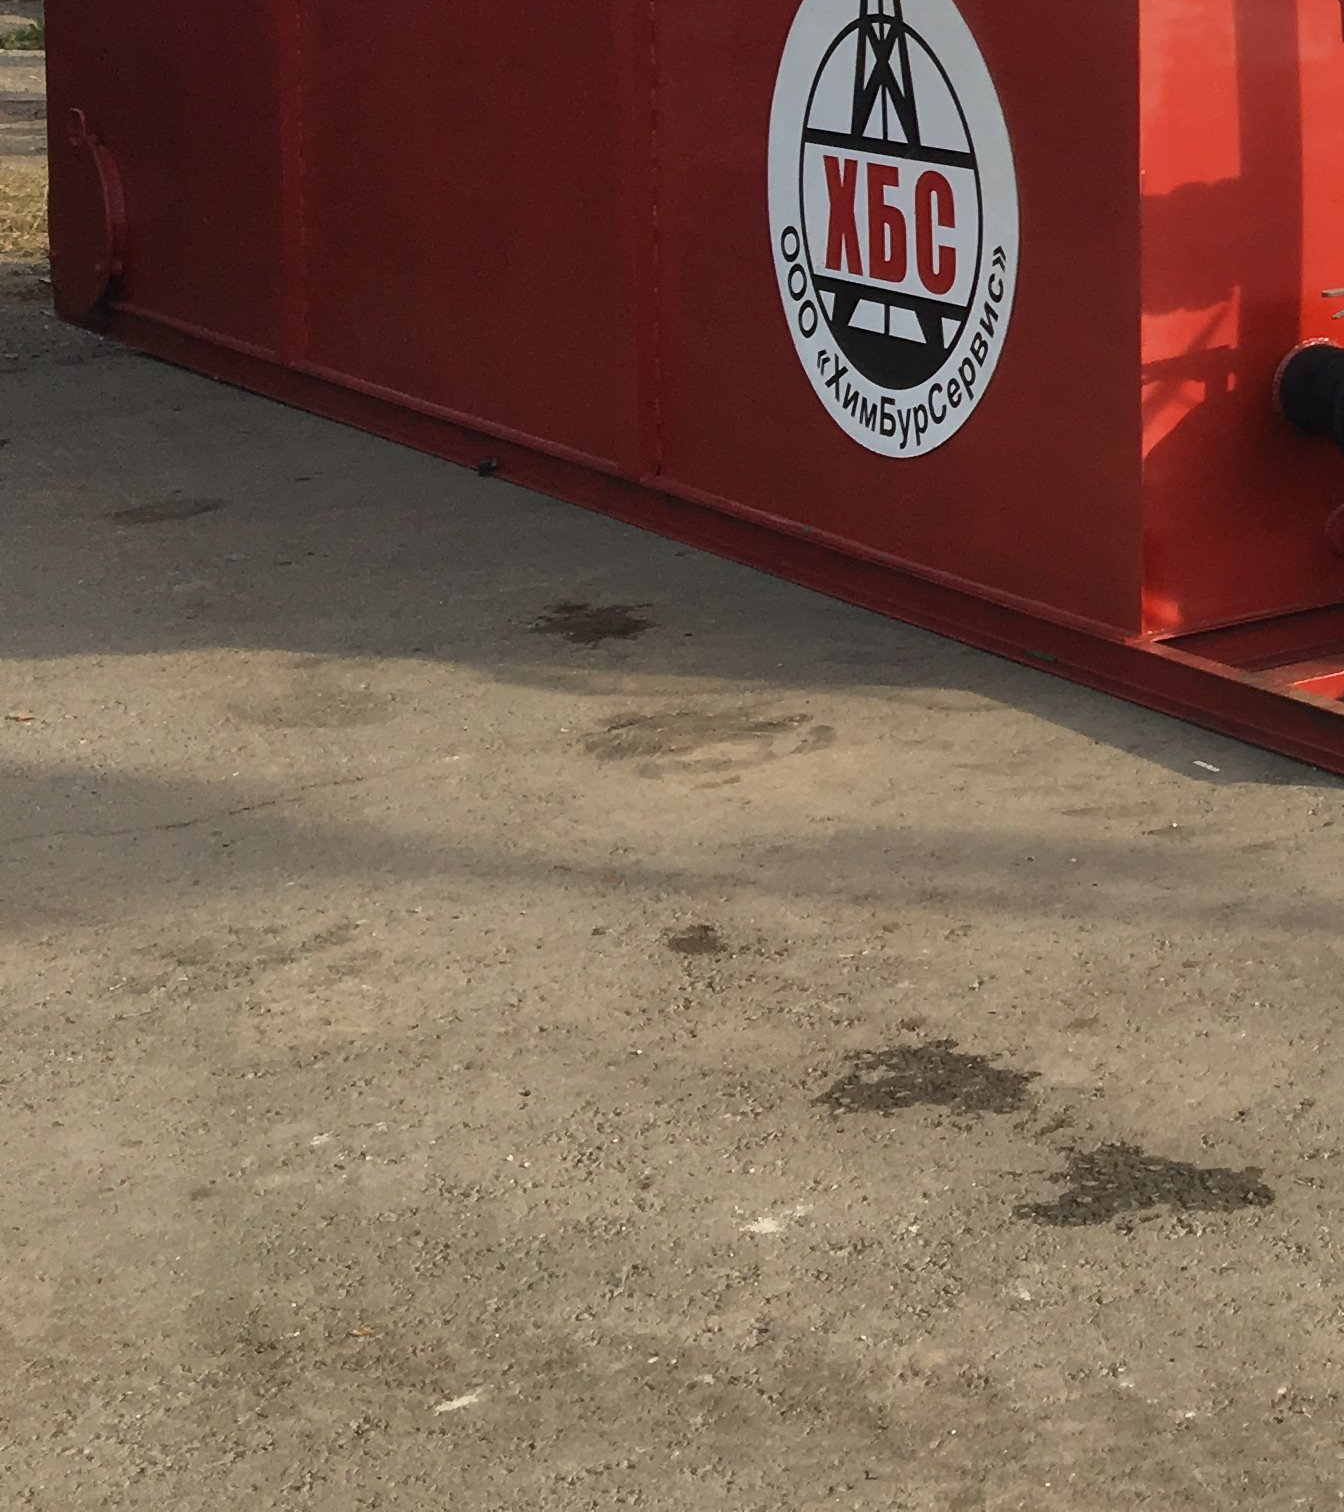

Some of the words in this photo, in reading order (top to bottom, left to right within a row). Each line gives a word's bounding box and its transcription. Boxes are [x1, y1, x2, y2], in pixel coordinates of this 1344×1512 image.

[823, 155, 957, 296] ХБС
[781, 225, 818, 339] ООО
[817, 245, 1007, 449] «ХимБурСервис»
